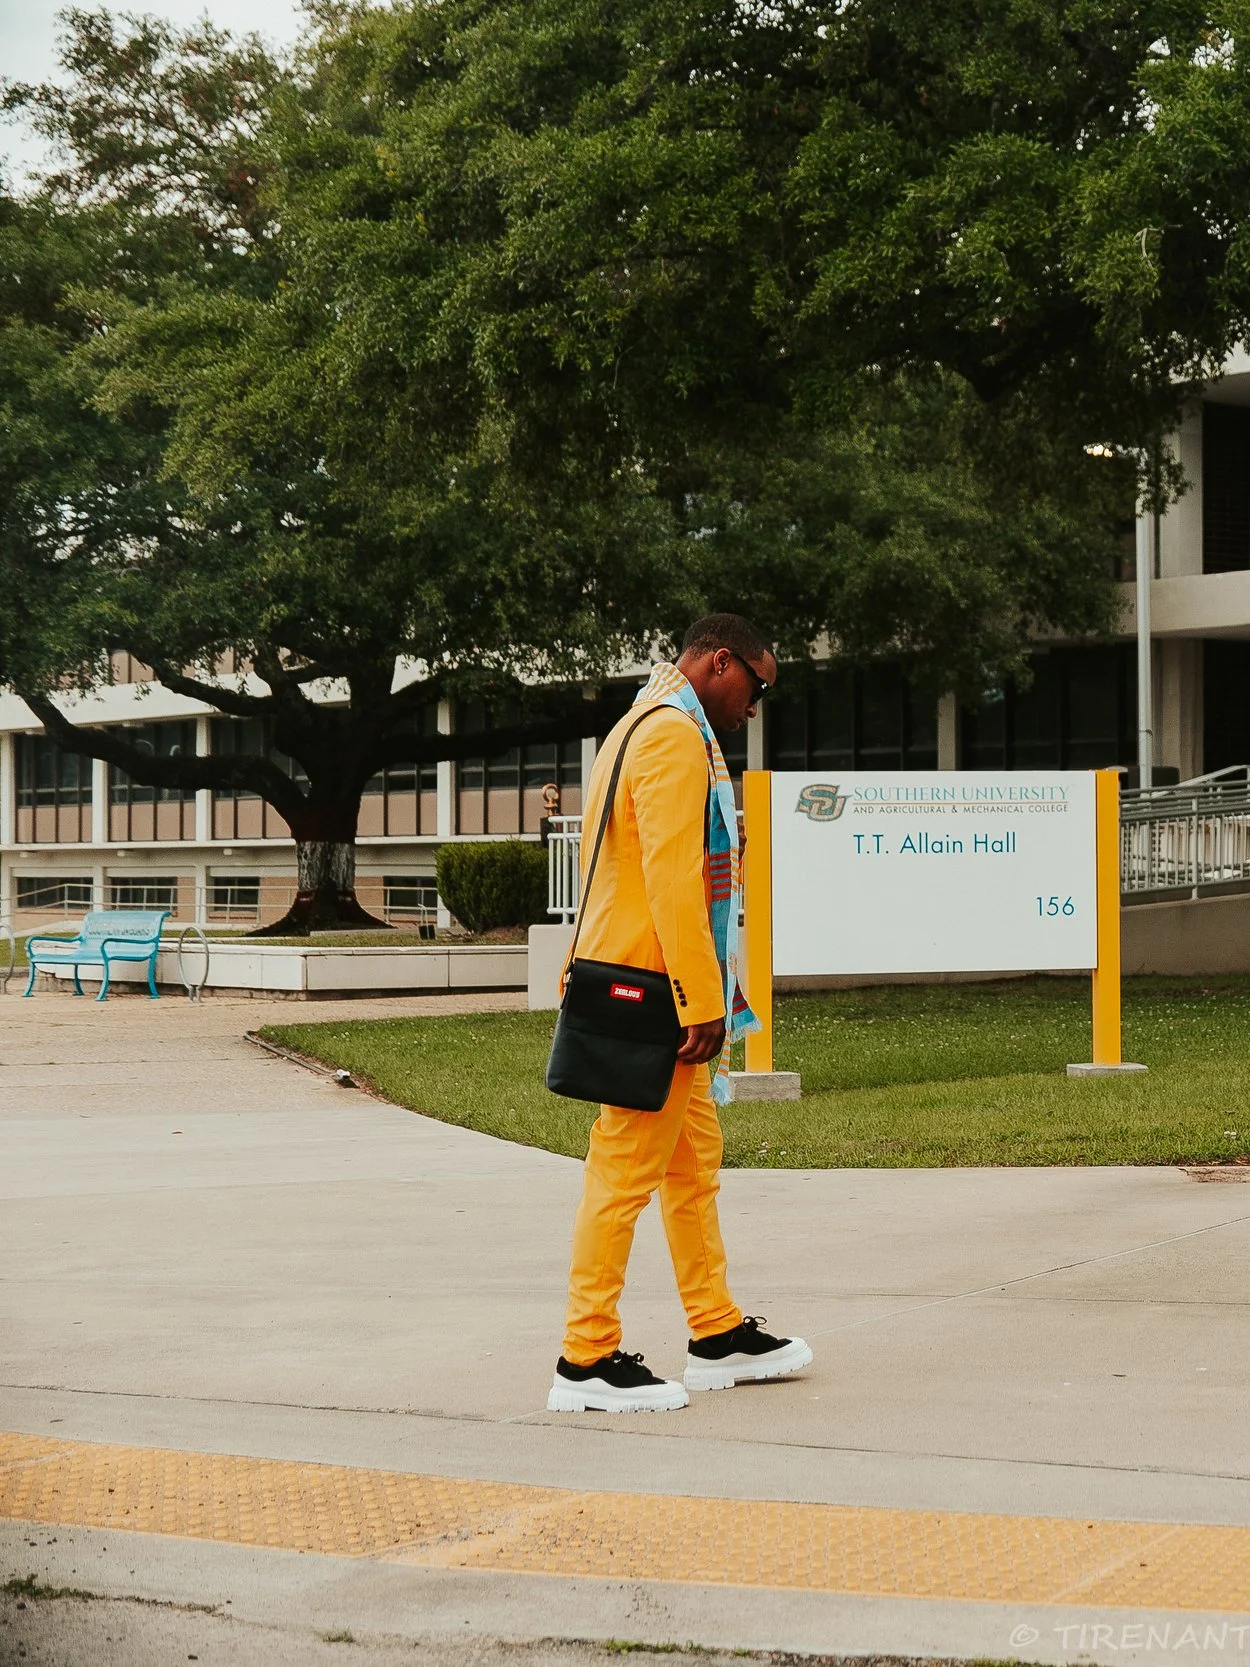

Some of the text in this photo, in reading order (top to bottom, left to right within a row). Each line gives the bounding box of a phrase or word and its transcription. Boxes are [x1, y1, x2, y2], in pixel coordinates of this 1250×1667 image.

[853, 785, 1070, 801] SOUTHERN UNIVERSITY
[853, 803, 1069, 815] AND AGRICULTURAL & MECHANICAL COLLEGE
[853, 831, 1017, 854] T.T. Allain Hall
[1035, 896, 1076, 917] 156
